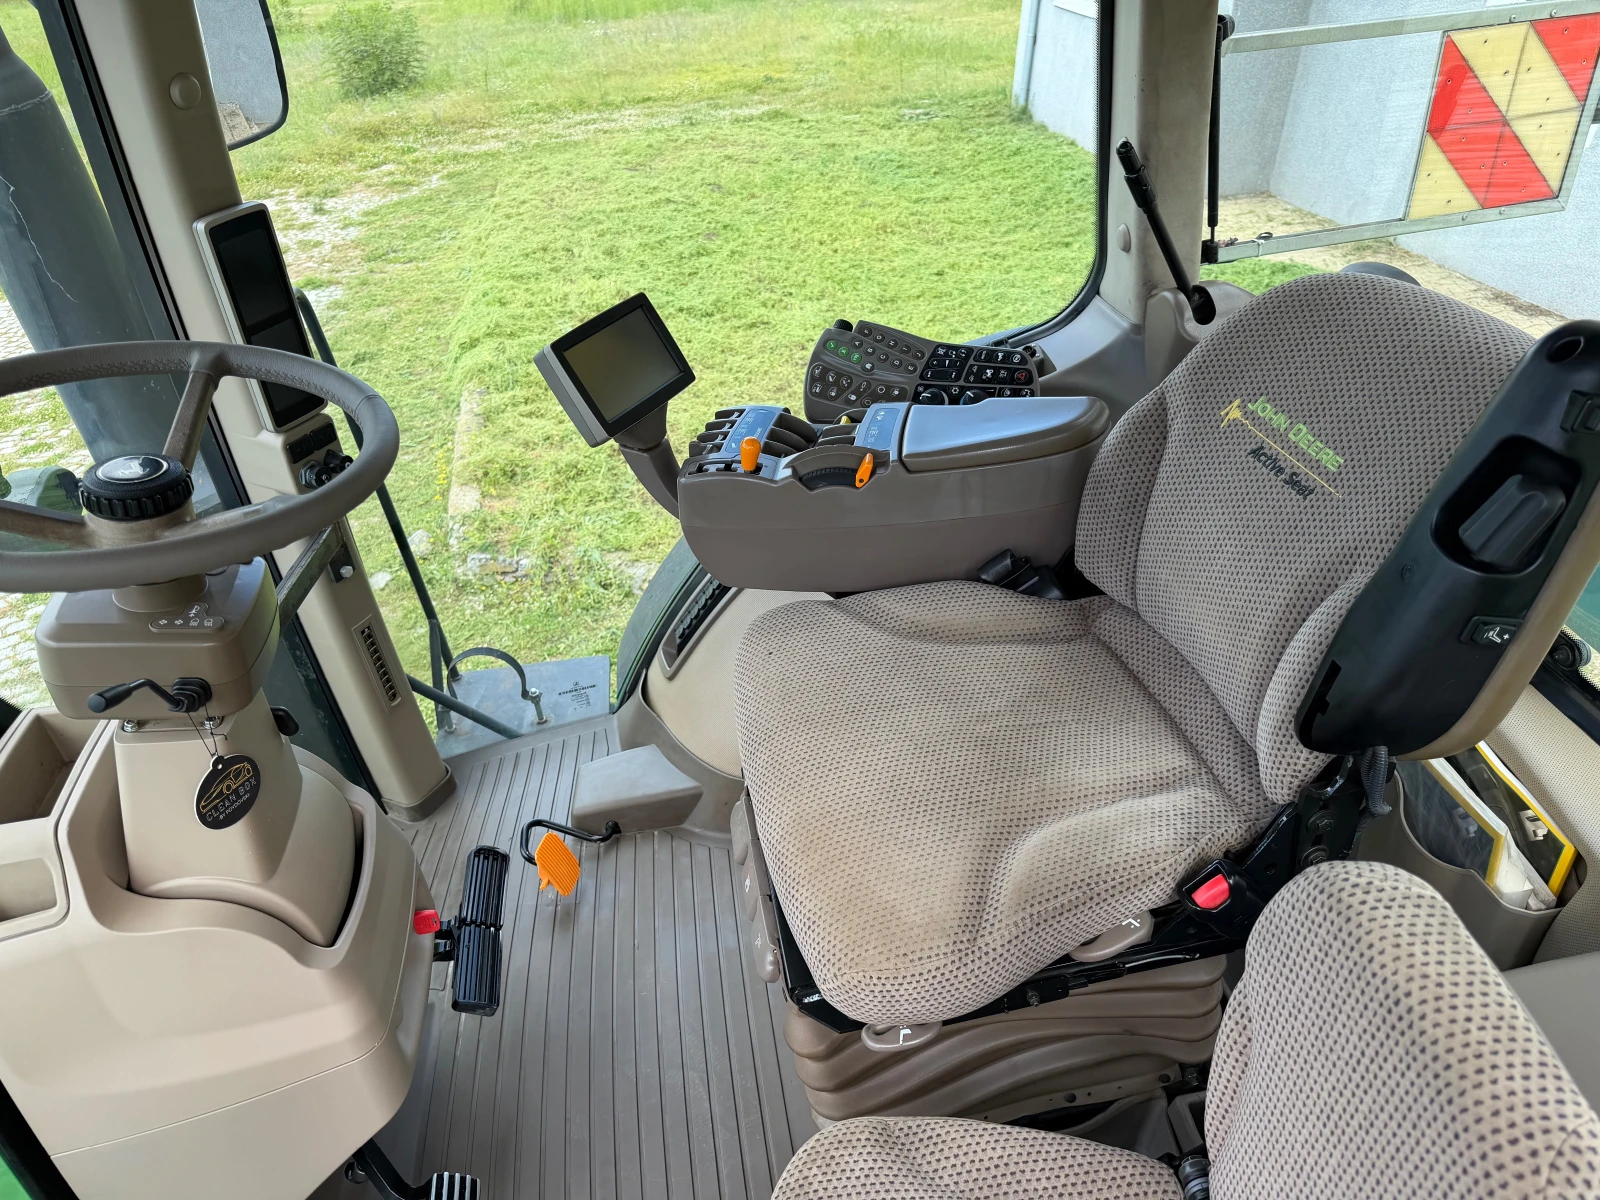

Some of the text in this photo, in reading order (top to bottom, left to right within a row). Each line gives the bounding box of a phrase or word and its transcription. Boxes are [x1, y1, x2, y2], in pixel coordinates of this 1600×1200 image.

[1247, 395, 1344, 472] JOHN DEERE
[1248, 444, 1316, 500] Active Seat
[206, 777, 257, 821] CLEAN BOX
